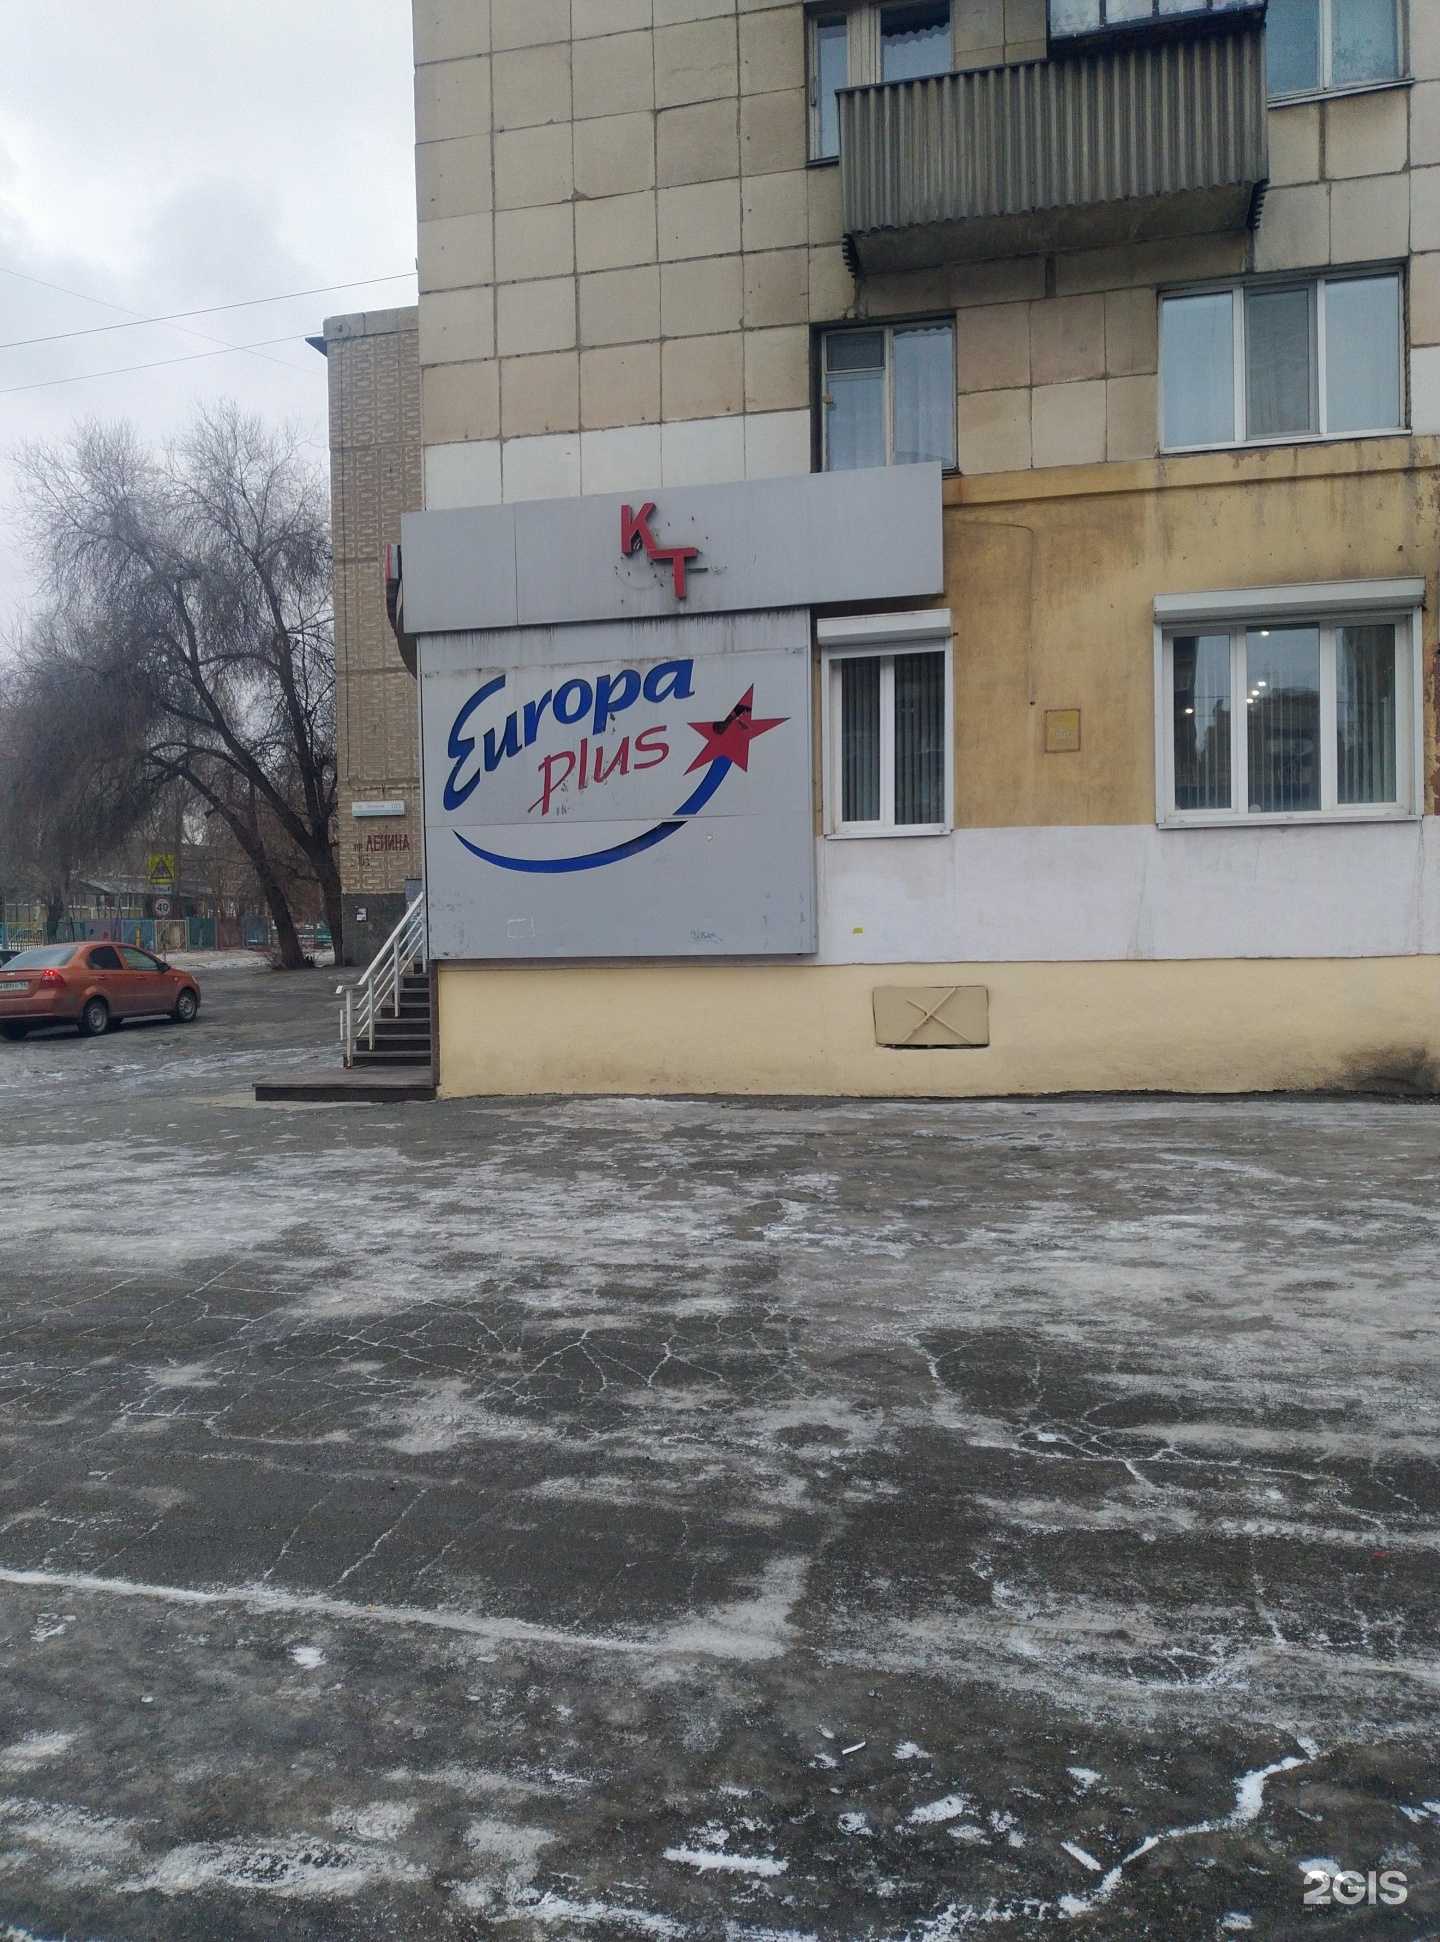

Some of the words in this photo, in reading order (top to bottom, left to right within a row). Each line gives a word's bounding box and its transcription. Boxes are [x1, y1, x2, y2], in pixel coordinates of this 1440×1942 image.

[443, 659, 696, 811] Europa
[528, 725, 669, 816] plus
[366, 834, 410, 851] ЛЕНИНА
